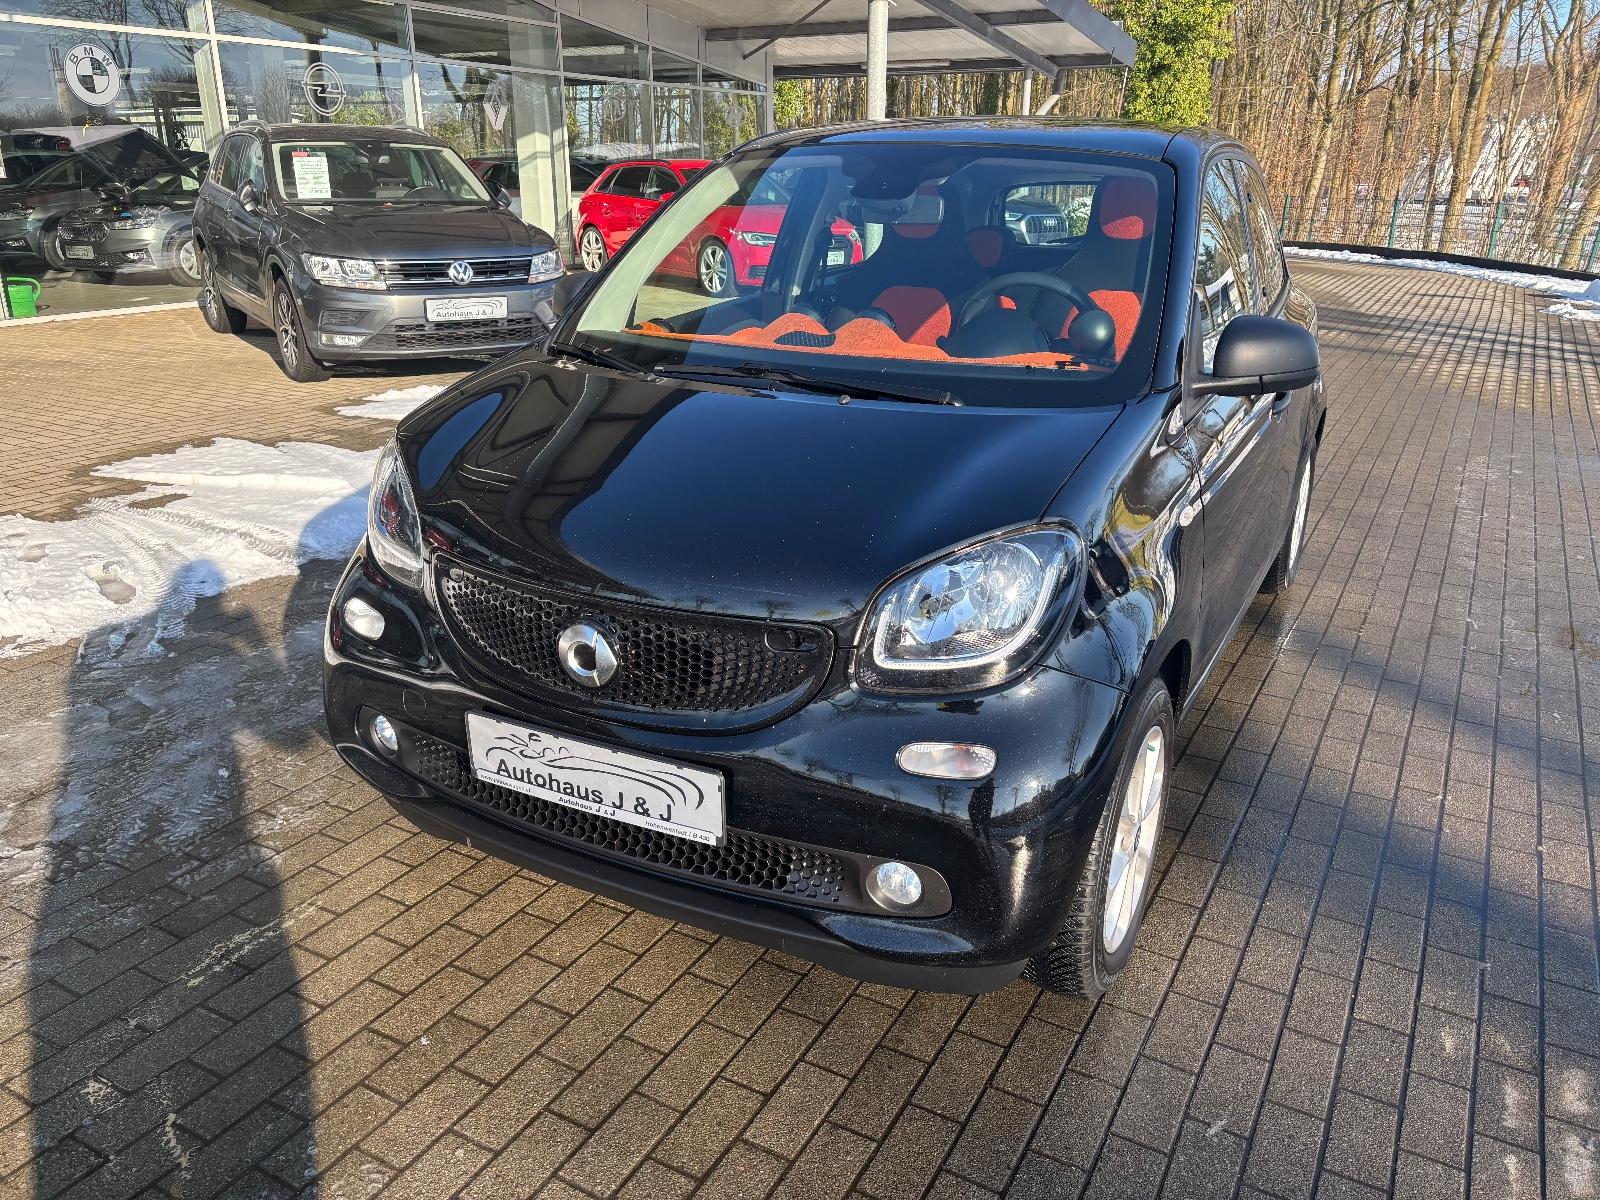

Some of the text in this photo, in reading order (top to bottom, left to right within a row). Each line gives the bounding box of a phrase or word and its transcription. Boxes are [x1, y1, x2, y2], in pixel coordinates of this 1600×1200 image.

[69, 46, 113, 67] BMW
[496, 758, 604, 805] Autohaus
[612, 792, 624, 810] J
[633, 797, 651, 818] &
[658, 803, 672, 822] J
[558, 796, 593, 811] Autohaus
[595, 805, 601, 813] J
